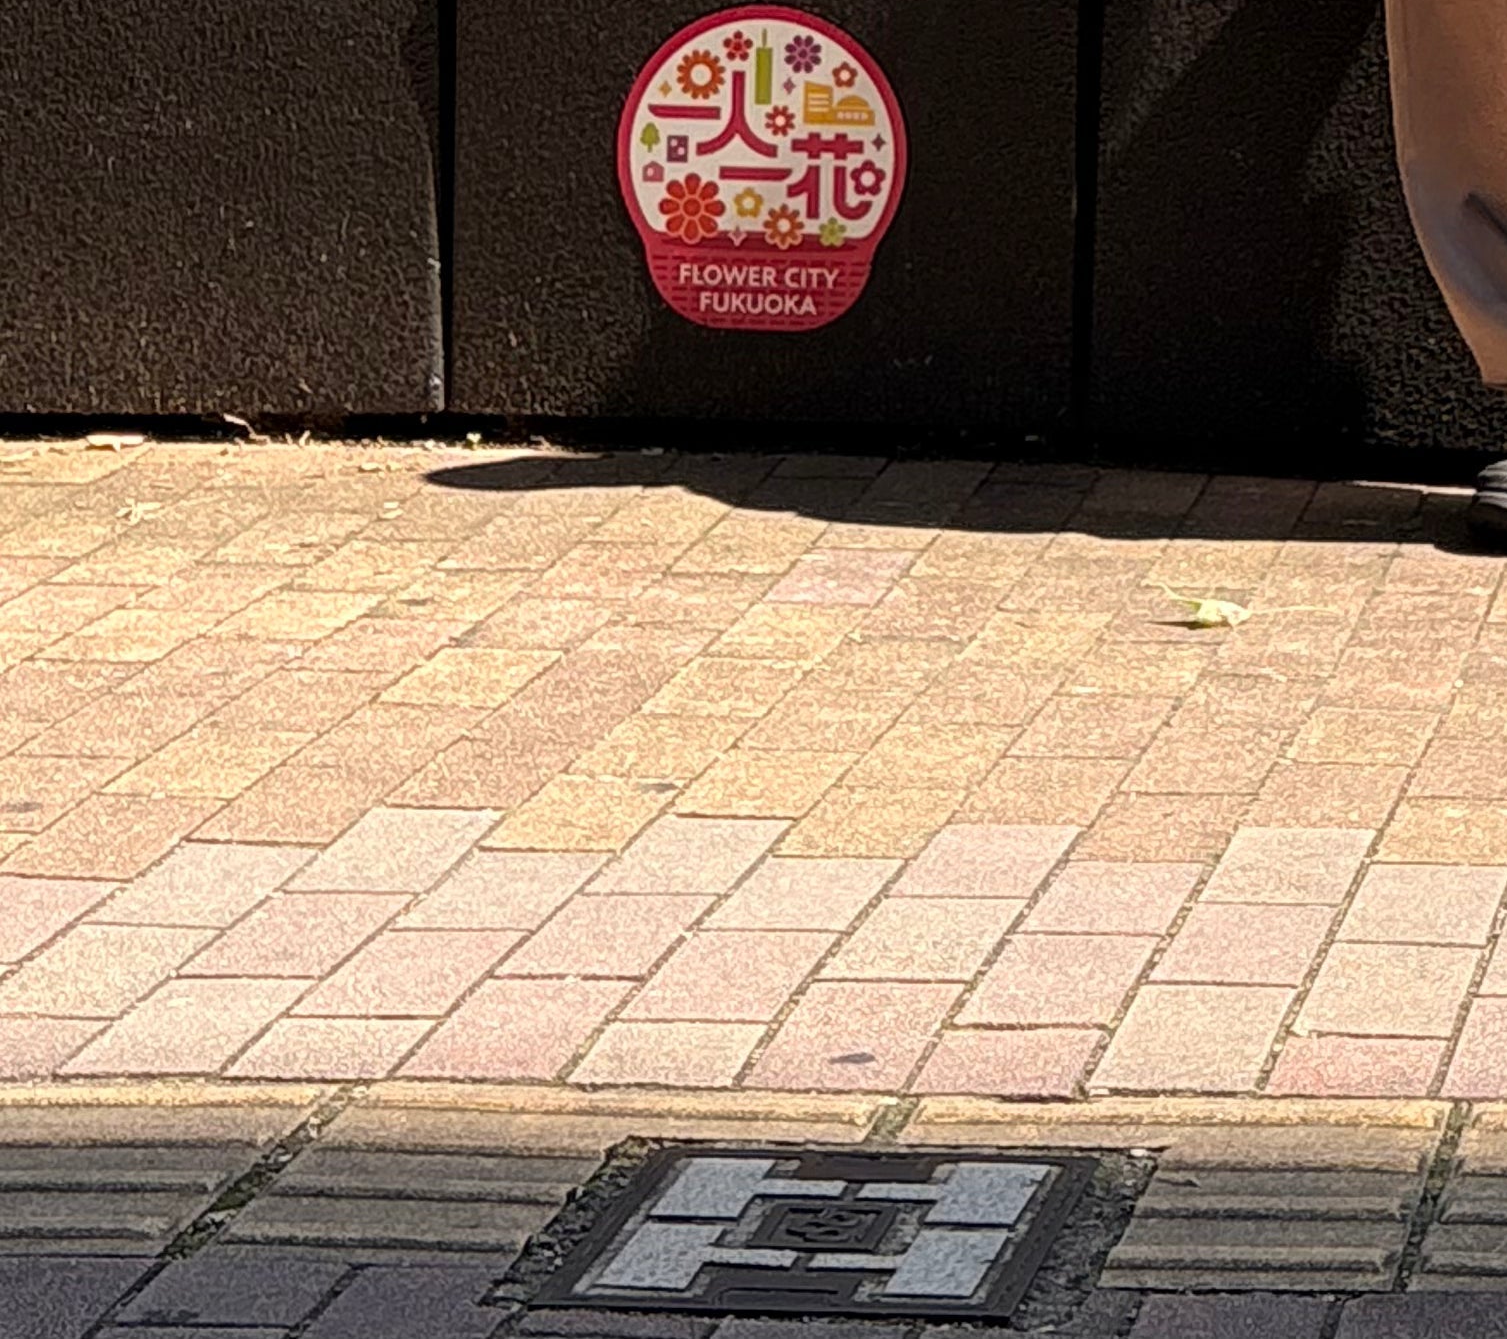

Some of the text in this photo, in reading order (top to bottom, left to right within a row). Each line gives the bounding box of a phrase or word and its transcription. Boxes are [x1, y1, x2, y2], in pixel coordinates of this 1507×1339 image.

[678, 262, 840, 288] FLOWER CITY
[699, 291, 818, 316] FUKUOKA
